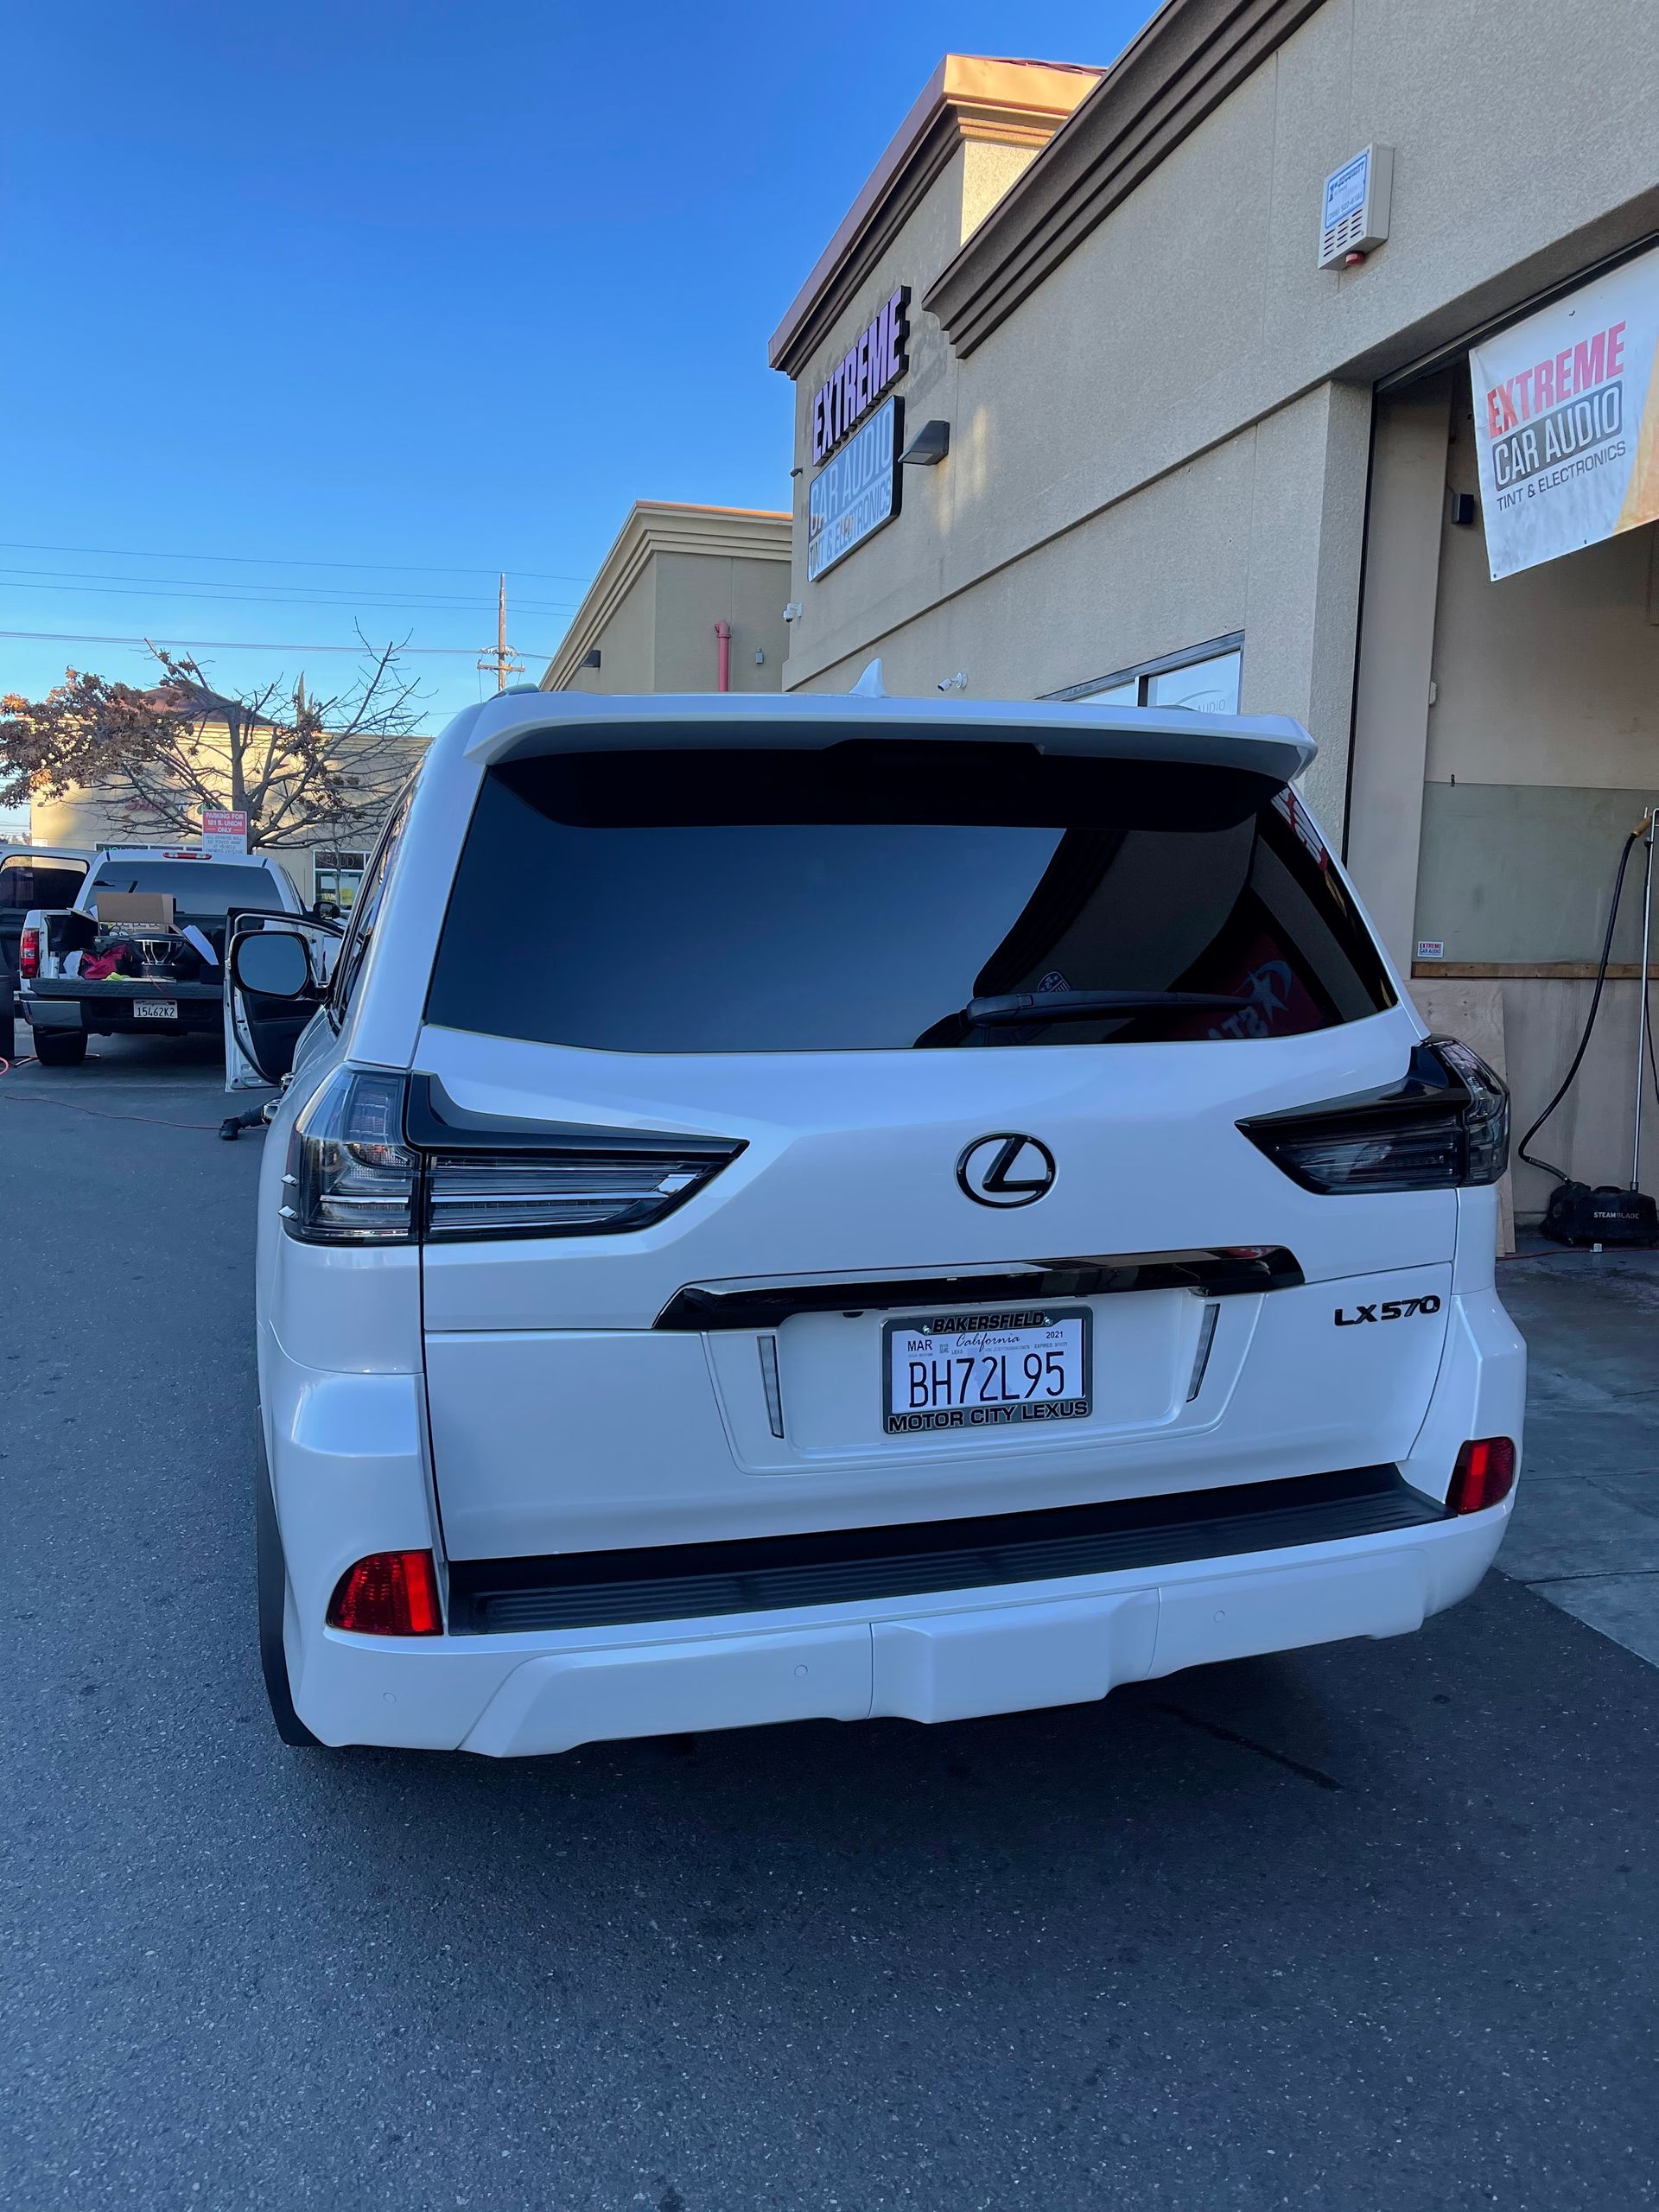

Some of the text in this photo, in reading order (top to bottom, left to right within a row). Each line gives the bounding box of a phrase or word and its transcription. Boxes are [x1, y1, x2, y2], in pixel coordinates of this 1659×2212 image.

[813, 285, 906, 467] EXTREME
[1487, 321, 1626, 439] EXTREME
[810, 403, 893, 537] CAR AUDIO
[1494, 386, 1620, 486] CAR AUDIO
[1497, 441, 1626, 511] TINT & ELECTRONICS
[834, 478, 892, 555] ELECTRONICS
[907, 1339, 933, 1351] MAR
[931, 1312, 1045, 1333] BAKERSFIELD
[956, 1332, 1020, 1351] California
[909, 1351, 1065, 1408] BH72L95
[887, 1401, 1088, 1433] MOTOR CITY LEXUS
